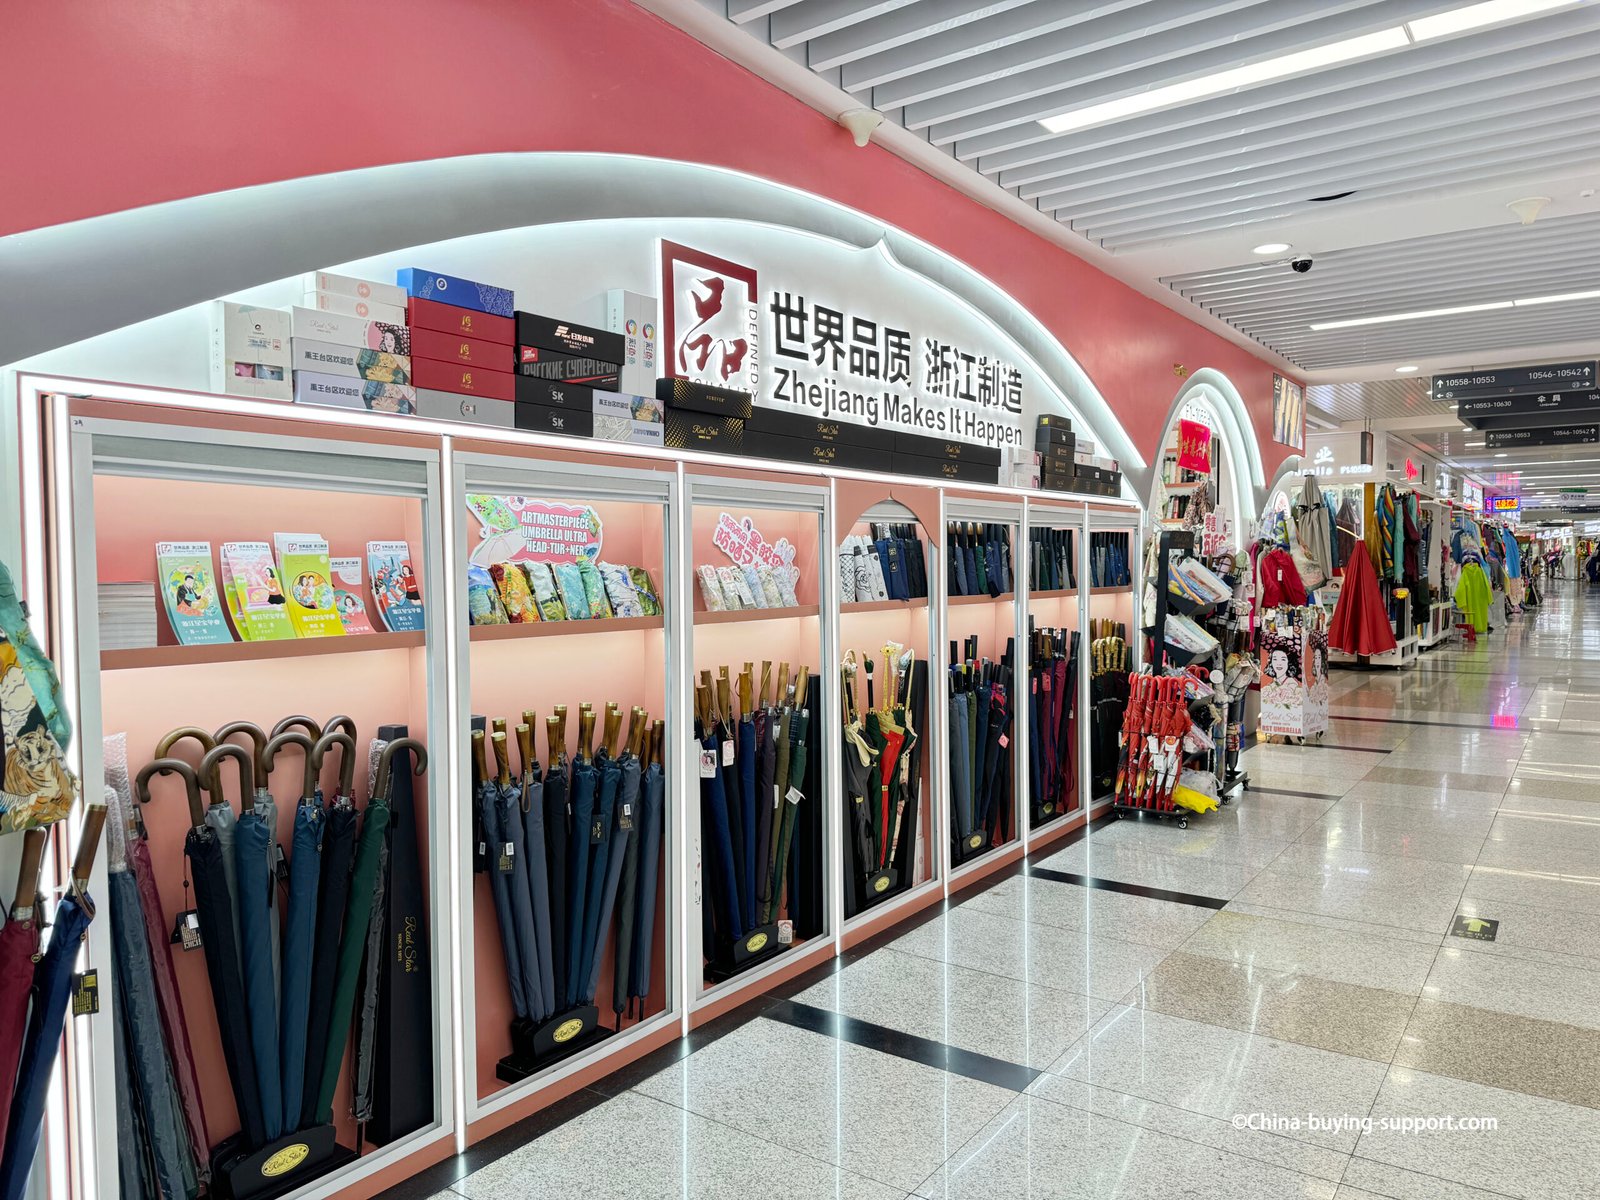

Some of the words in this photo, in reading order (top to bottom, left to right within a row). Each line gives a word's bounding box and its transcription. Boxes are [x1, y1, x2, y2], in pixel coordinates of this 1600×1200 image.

[749, 308, 759, 385] DEFINED
[770, 291, 912, 388] 世界品质
[925, 338, 1023, 415] 浙江制造
[1445, 376, 1496, 387] 10558-10553
[1528, 368, 1582, 380] 10546-10542
[552, 391, 564, 401] SK
[773, 367, 879, 425] Zhejiang
[884, 397, 946, 432] Makes
[950, 406, 962, 434] It
[965, 411, 1023, 446] Happen
[1473, 401, 1512, 409] 10553-10630
[552, 417, 564, 427] SK
[521, 510, 589, 530] ARTMASTERPIECE
[521, 525, 563, 542] UMBRELLA
[564, 530, 588, 544] ULTRA
[526, 540, 585, 556] HEAD-TUR+NER
[1273, 726, 1302, 735] UMBRELLA
[404, 916, 417, 945] Real
[404, 945, 418, 973] Star
